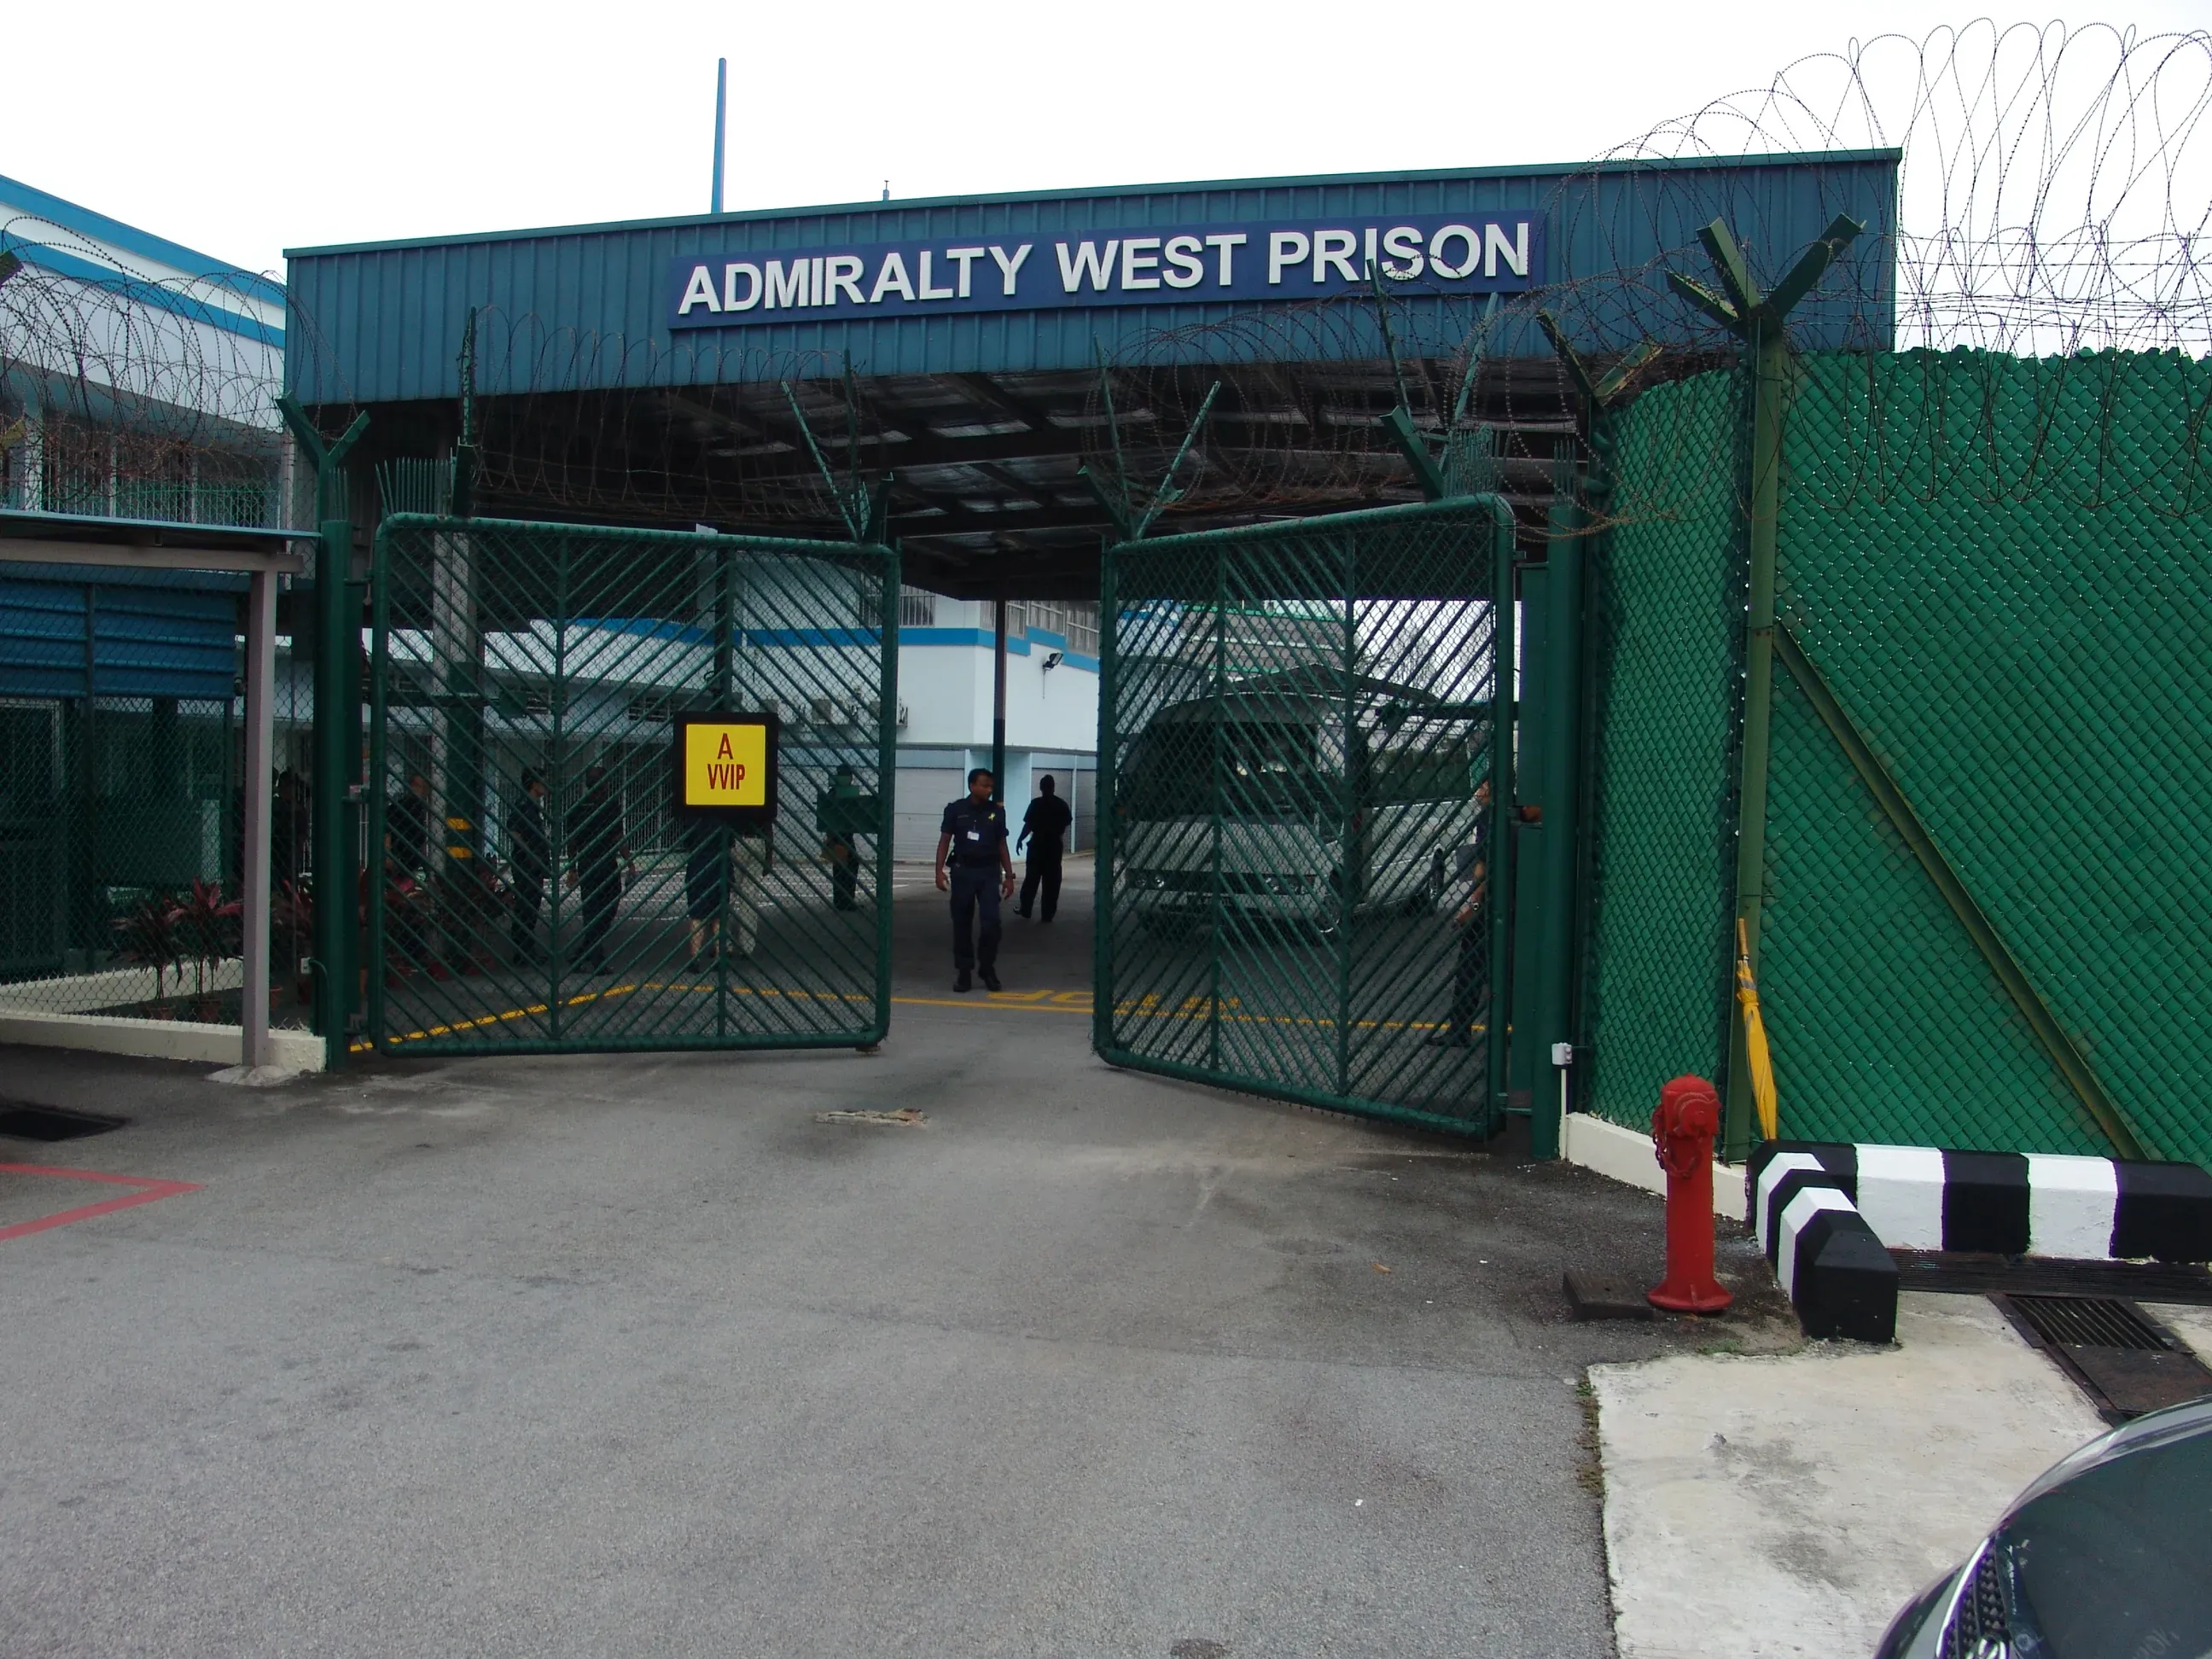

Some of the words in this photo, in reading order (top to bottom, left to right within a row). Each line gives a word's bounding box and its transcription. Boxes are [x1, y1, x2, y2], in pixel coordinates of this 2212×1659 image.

[678, 244, 1033, 315] ADMIRALTY
[1055, 233, 1247, 292] WEST
[1268, 222, 1529, 284] PRISON
[717, 732, 734, 760] A
[707, 763, 746, 790] VVIP
